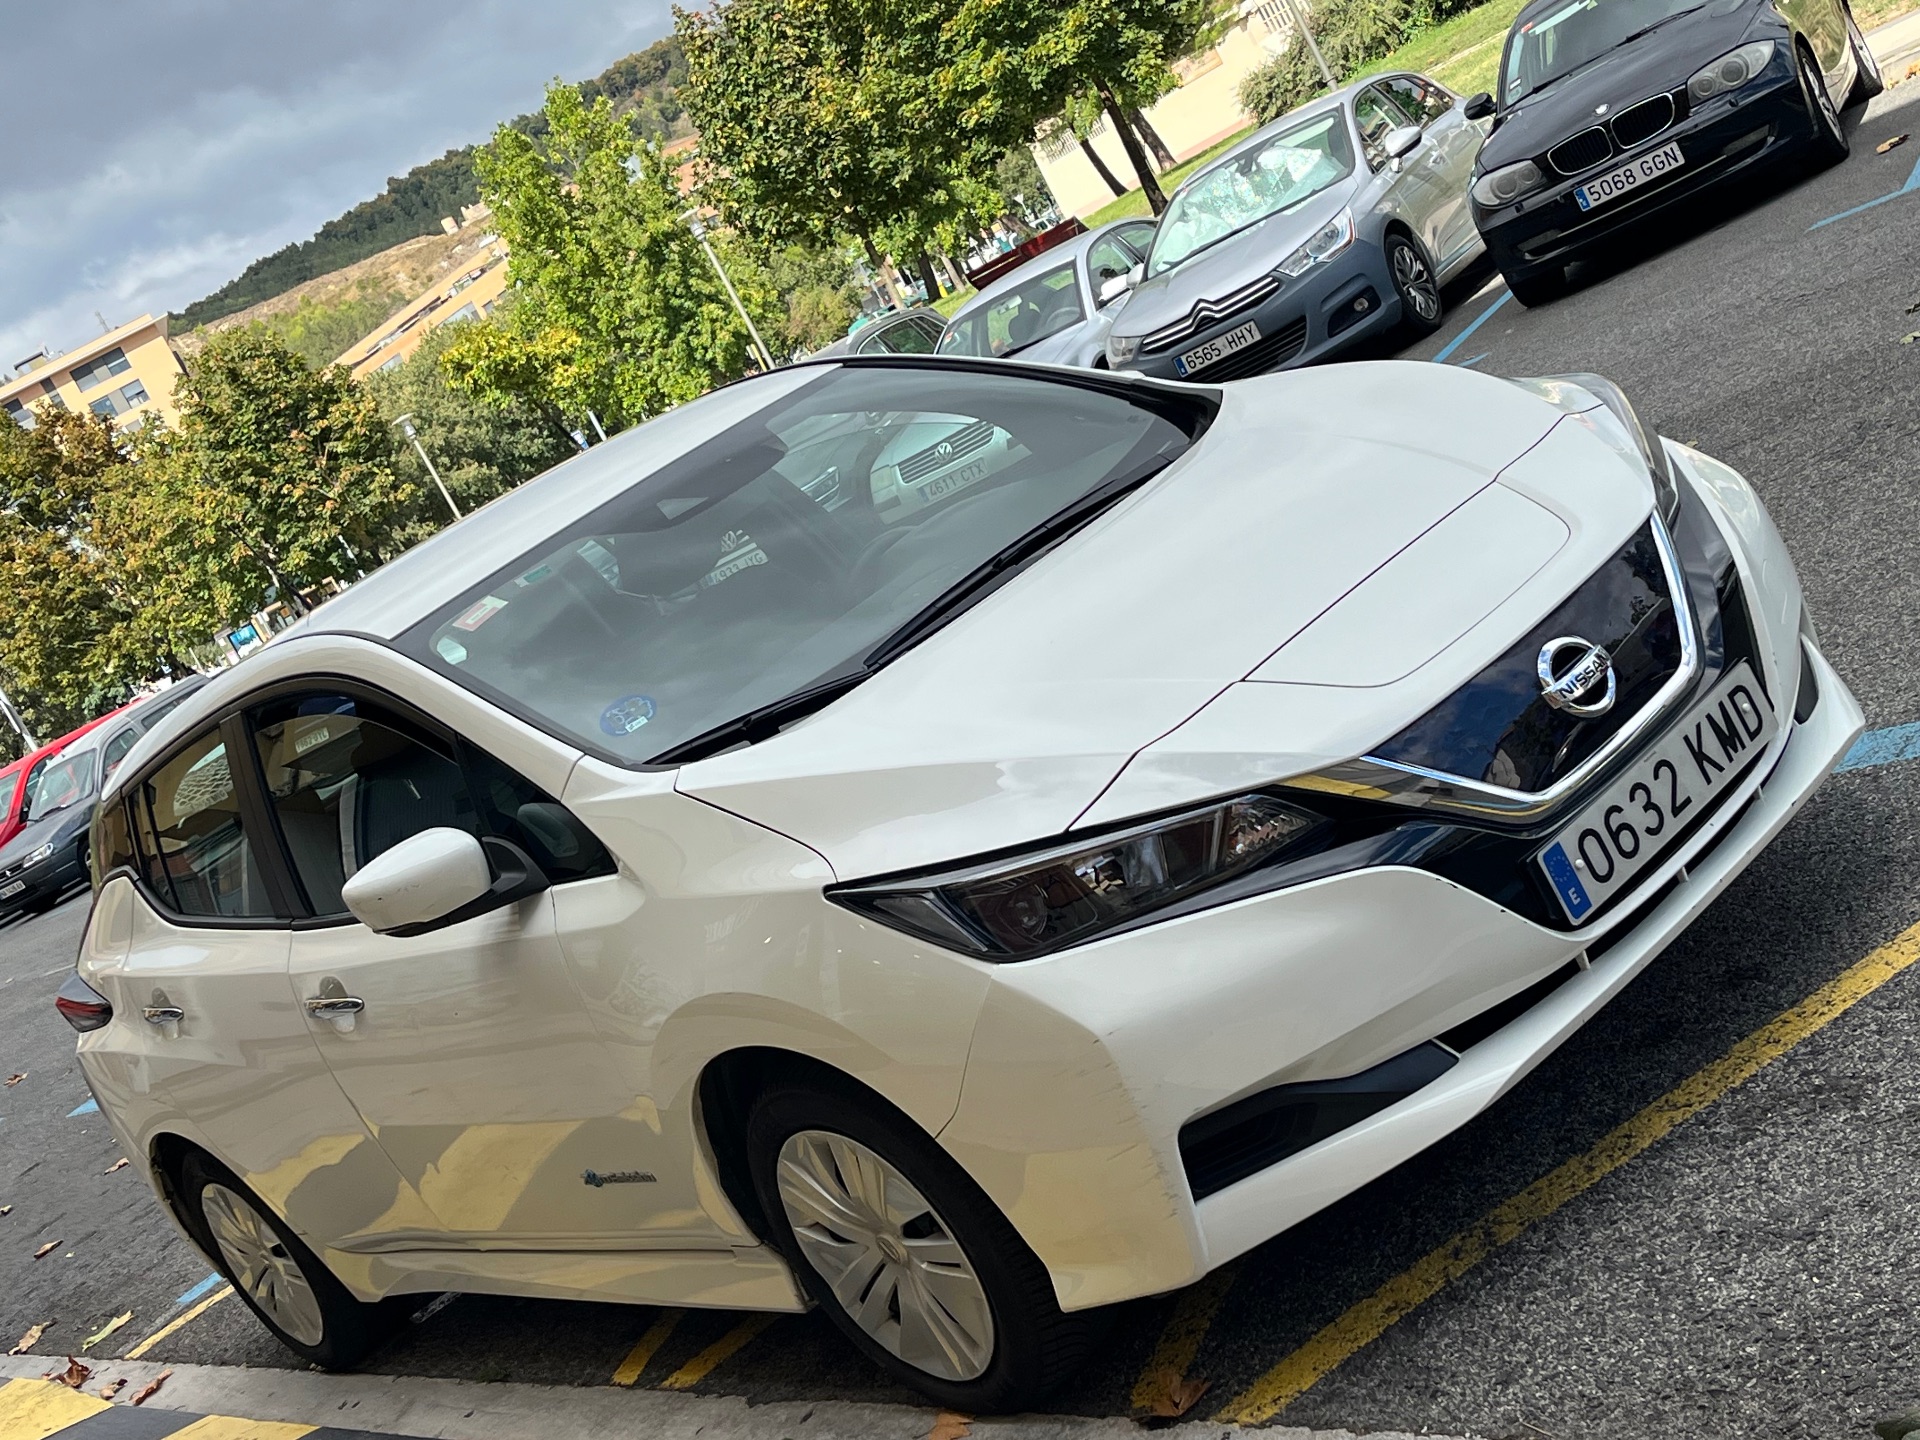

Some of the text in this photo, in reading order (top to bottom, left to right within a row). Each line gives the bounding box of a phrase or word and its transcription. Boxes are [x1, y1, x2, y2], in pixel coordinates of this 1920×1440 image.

[1587, 147, 1680, 202] 5068 GGN
[1185, 324, 1255, 370] 6565 HHY
[929, 463, 985, 496] 4611 CTX
[1558, 651, 1609, 699] NISSAN
[1567, 684, 1764, 906] E 0632 KMD
